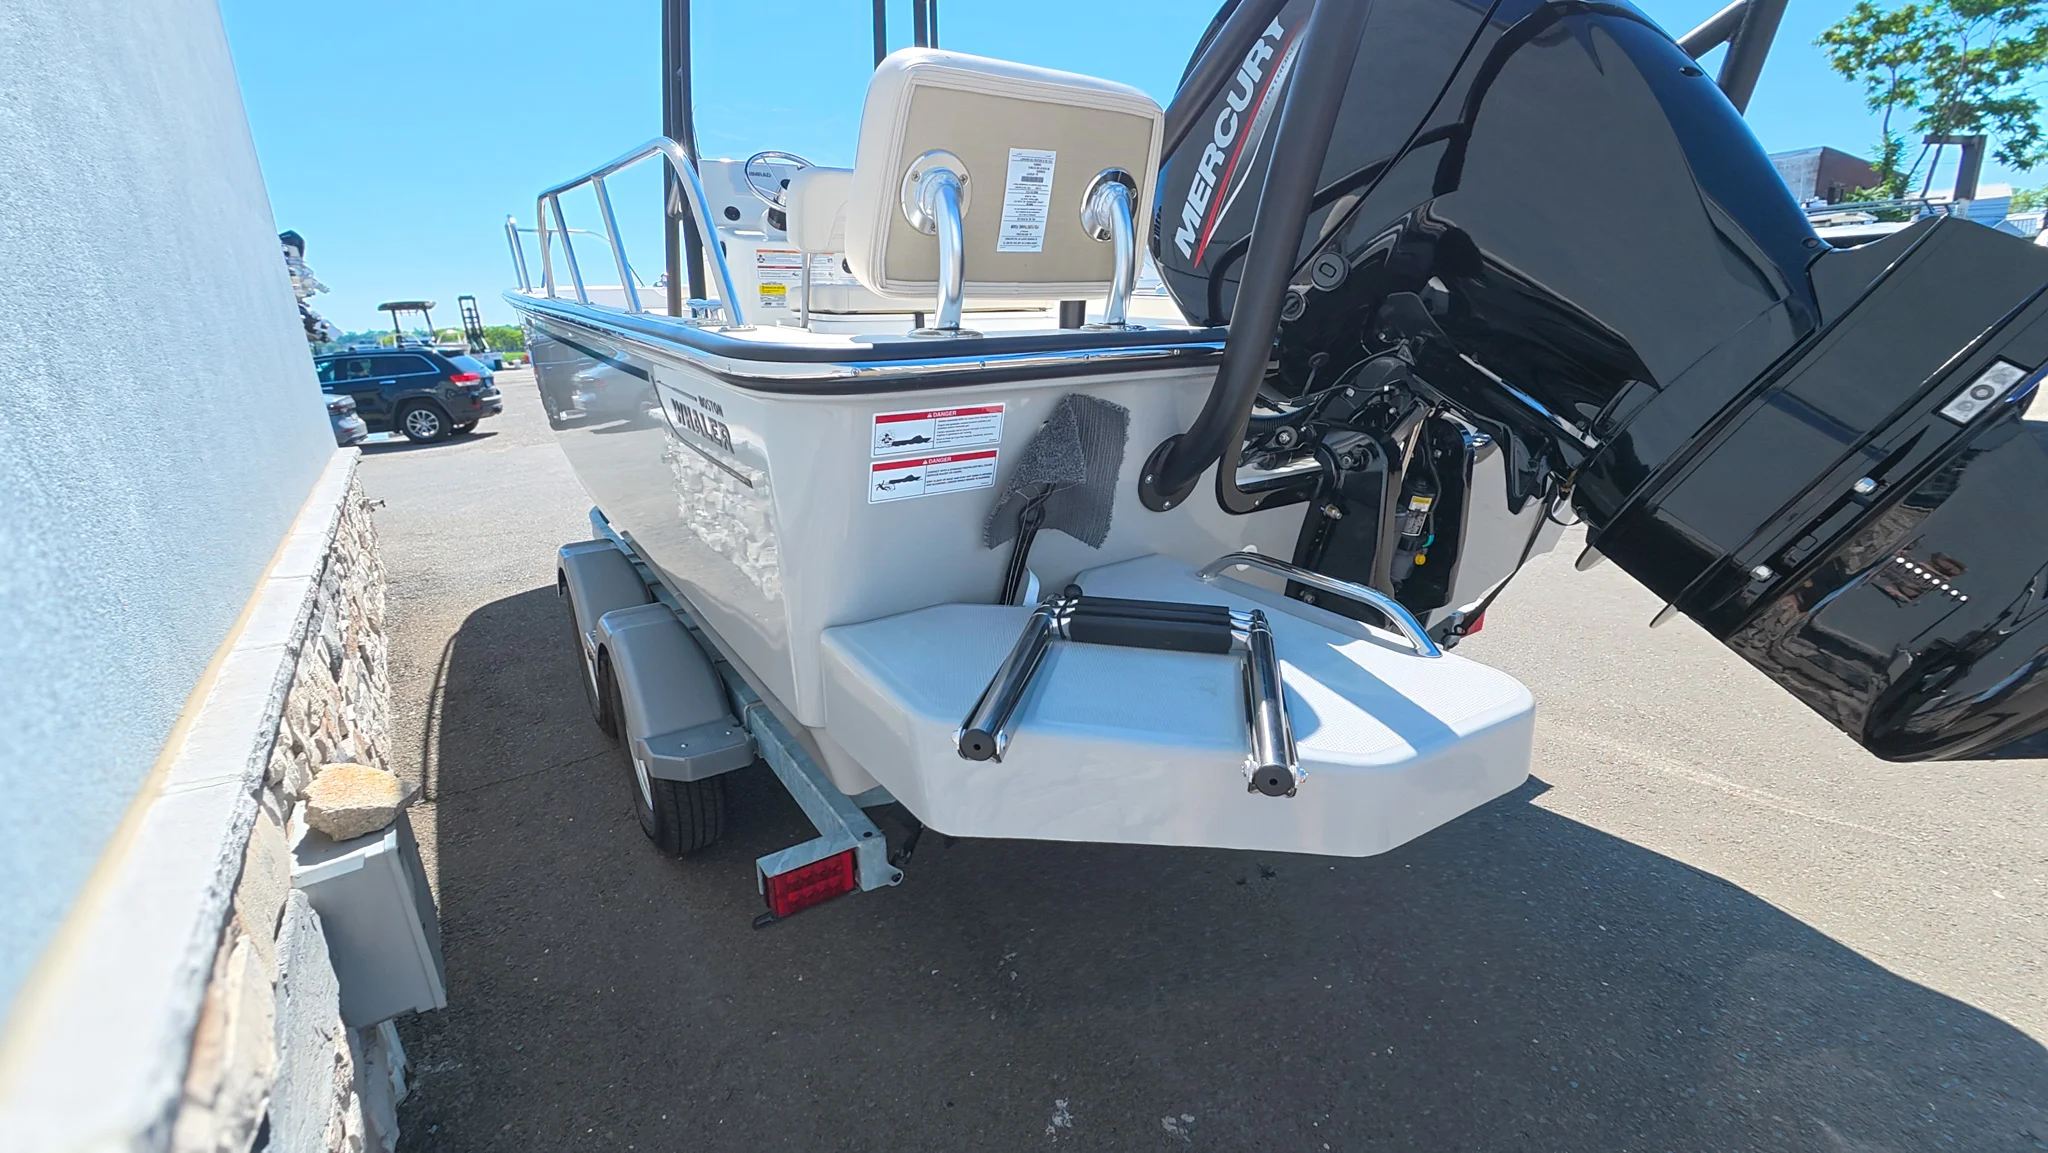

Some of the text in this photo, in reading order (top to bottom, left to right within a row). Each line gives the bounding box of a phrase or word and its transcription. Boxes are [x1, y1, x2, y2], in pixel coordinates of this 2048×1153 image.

[1174, 15, 1285, 260] MERCURY
[698, 394, 724, 417] BOSTON
[932, 410, 957, 418] DANGER
[670, 398, 735, 454] WHALER
[928, 456, 952, 464] DANGER
